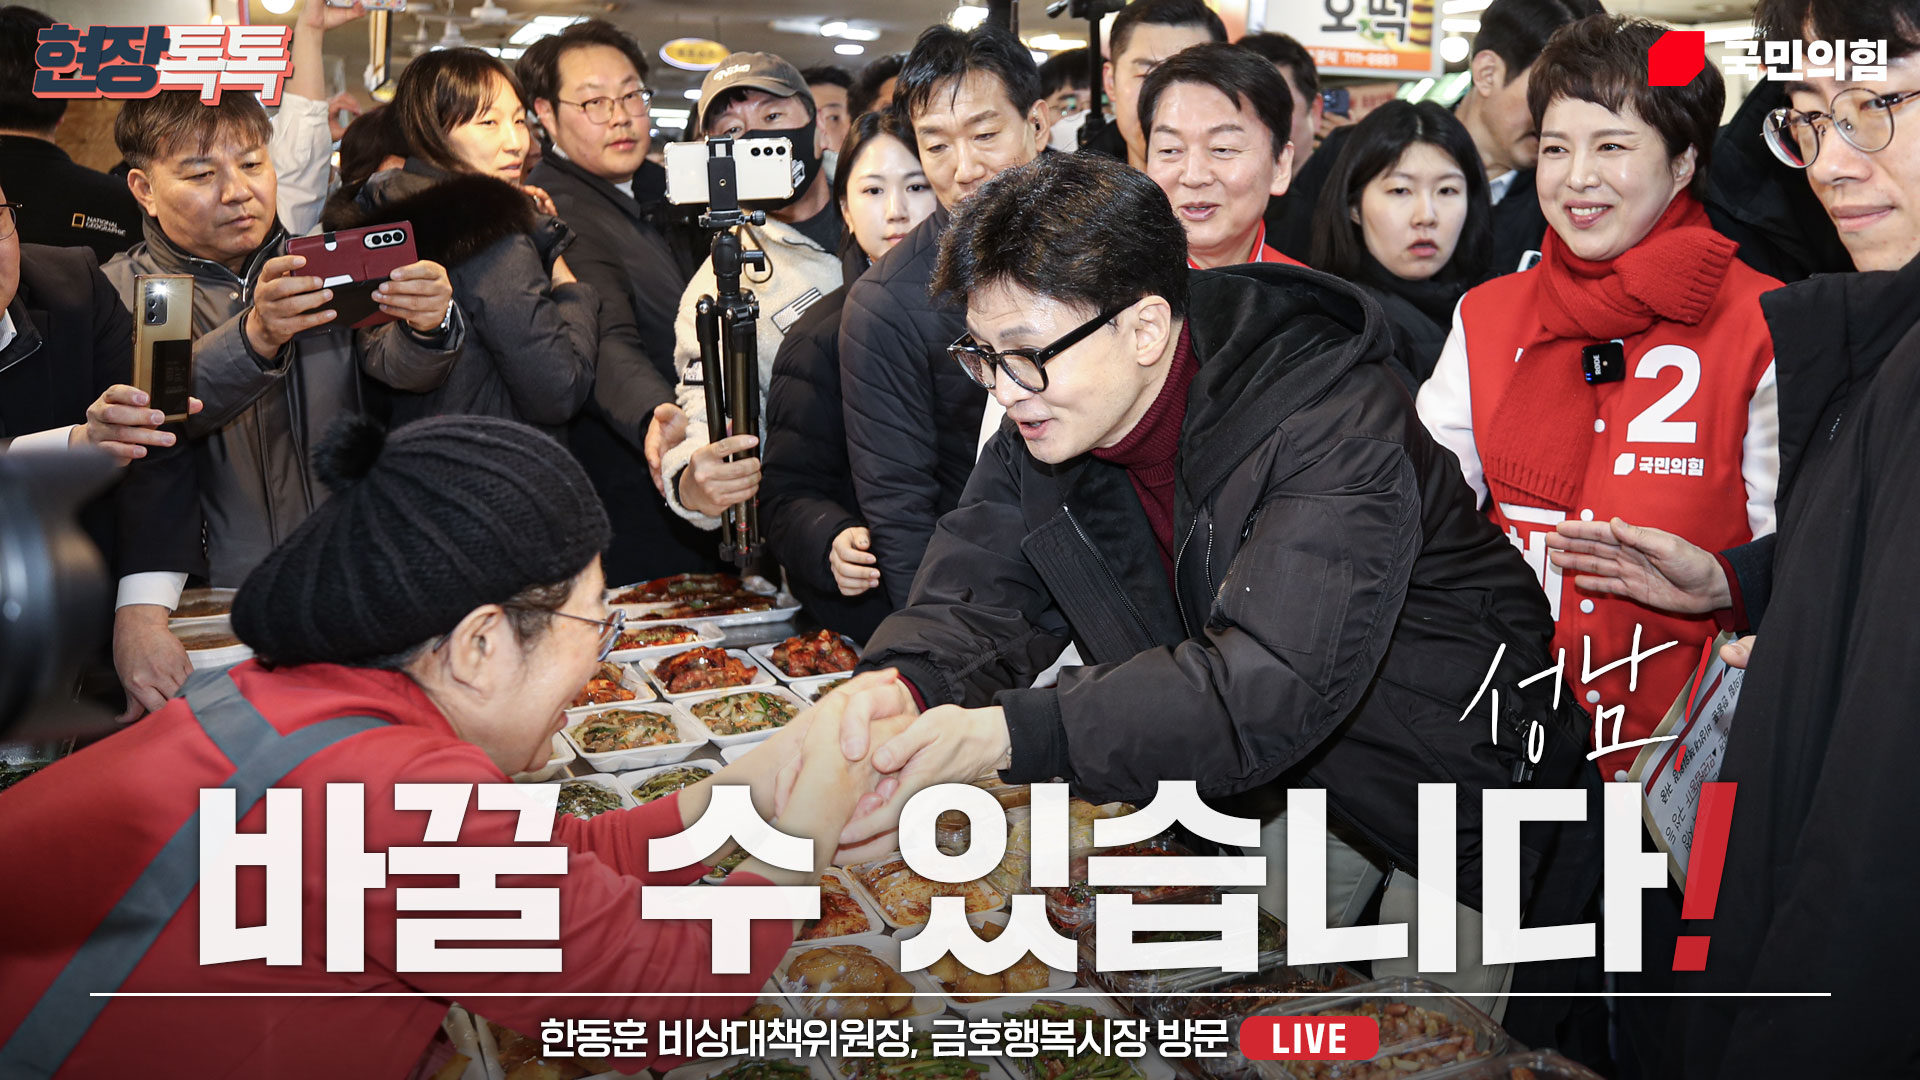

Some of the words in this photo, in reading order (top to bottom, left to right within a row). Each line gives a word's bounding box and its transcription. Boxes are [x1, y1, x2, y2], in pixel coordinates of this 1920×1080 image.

[85, 221, 126, 237] GEOGRAPHIC
[86, 215, 118, 229] NATIONAL
[1626, 344, 1701, 443] 2
[1639, 456, 1705, 477] 국민의힘
[1711, 695, 1730, 725] 한동훈
[1660, 782, 1674, 805] 귀중
[1671, 806, 1687, 832] 구성
